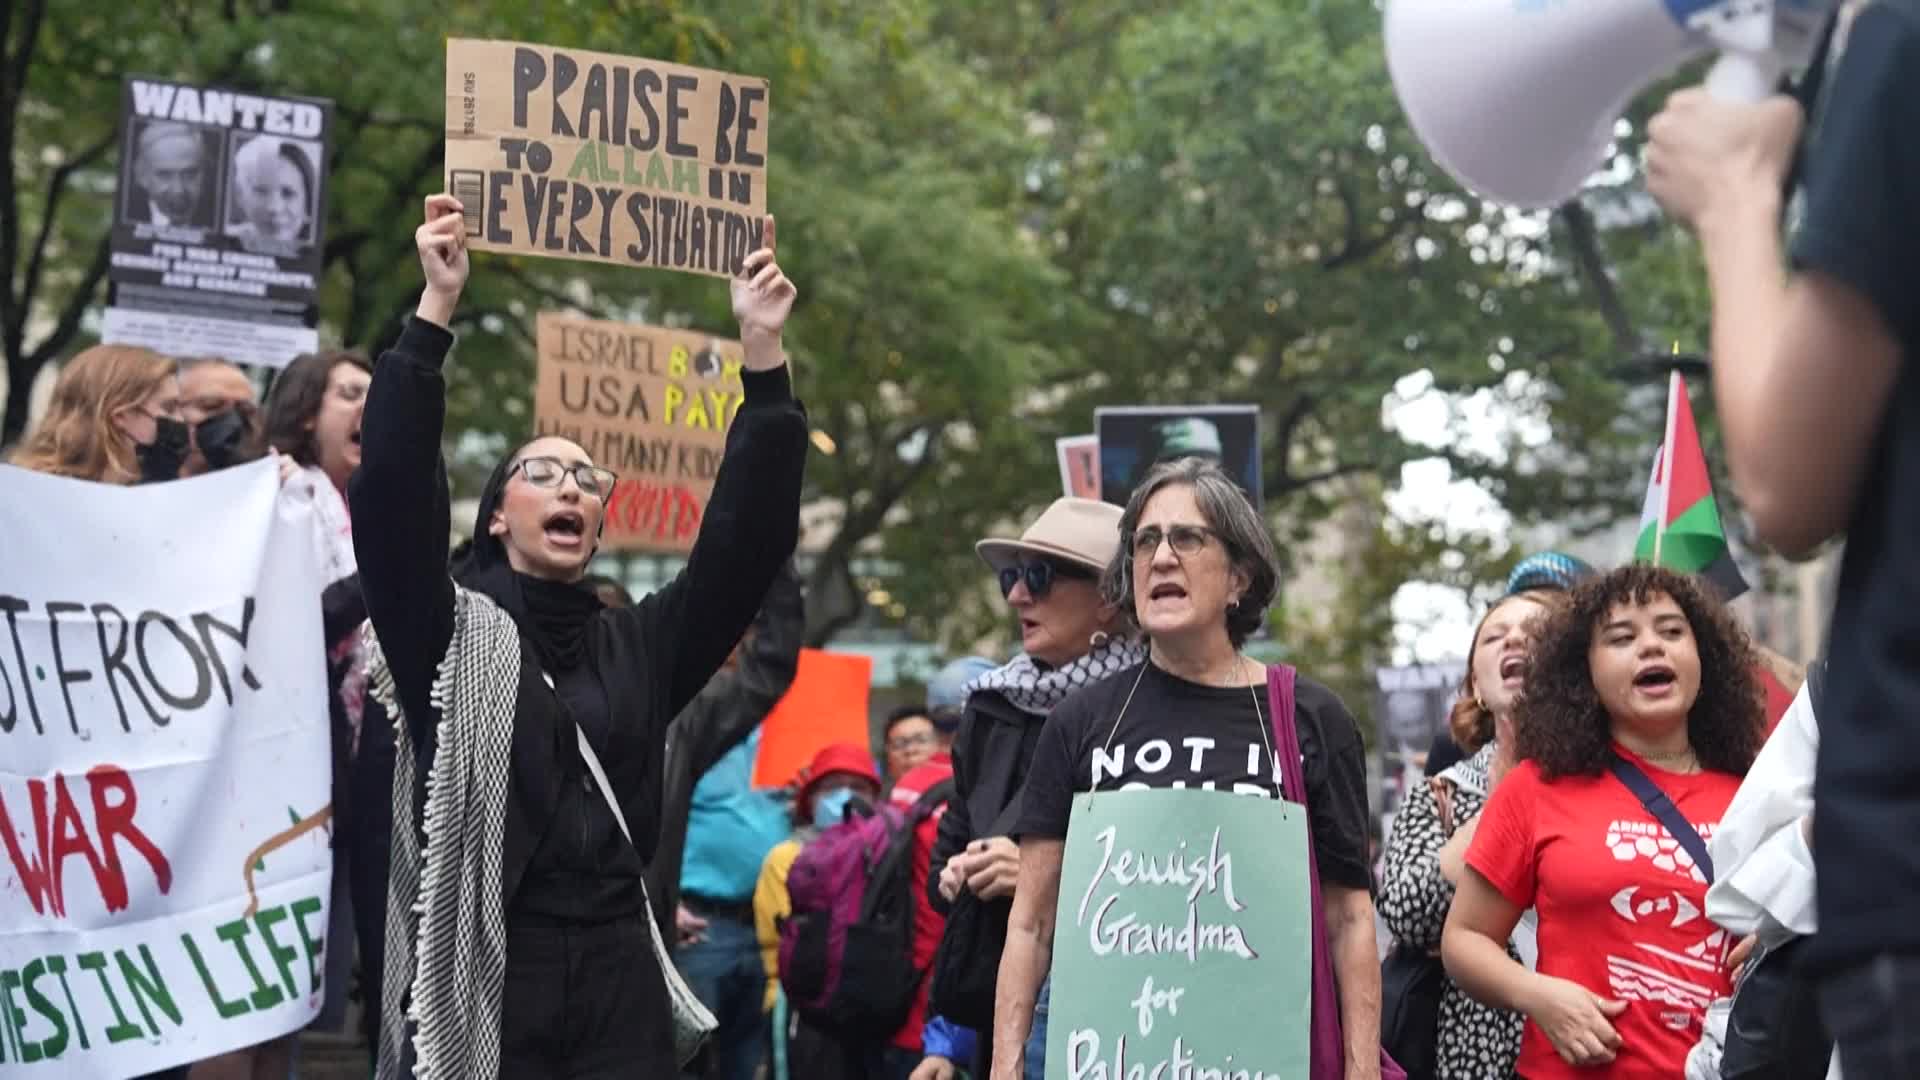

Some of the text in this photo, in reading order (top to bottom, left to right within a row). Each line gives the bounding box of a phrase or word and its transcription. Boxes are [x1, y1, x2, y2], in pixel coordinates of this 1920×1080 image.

[132, 80, 322, 138] WANTED
[514, 47, 765, 167] PRAISE BE
[500, 138, 750, 205] TO ALLAH IN
[487, 170, 623, 257] EVERY
[551, 323, 662, 376] ISRAEL
[561, 370, 649, 424] USA
[1091, 737, 1215, 784] NOT
[0, 764, 172, 918] WAR
[1077, 825, 1246, 927] Jewish
[1089, 893, 1259, 963] Grandma
[77, 943, 183, 1044] IN
[180, 896, 323, 1019] LIFE
[1131, 976, 1184, 1036] for
